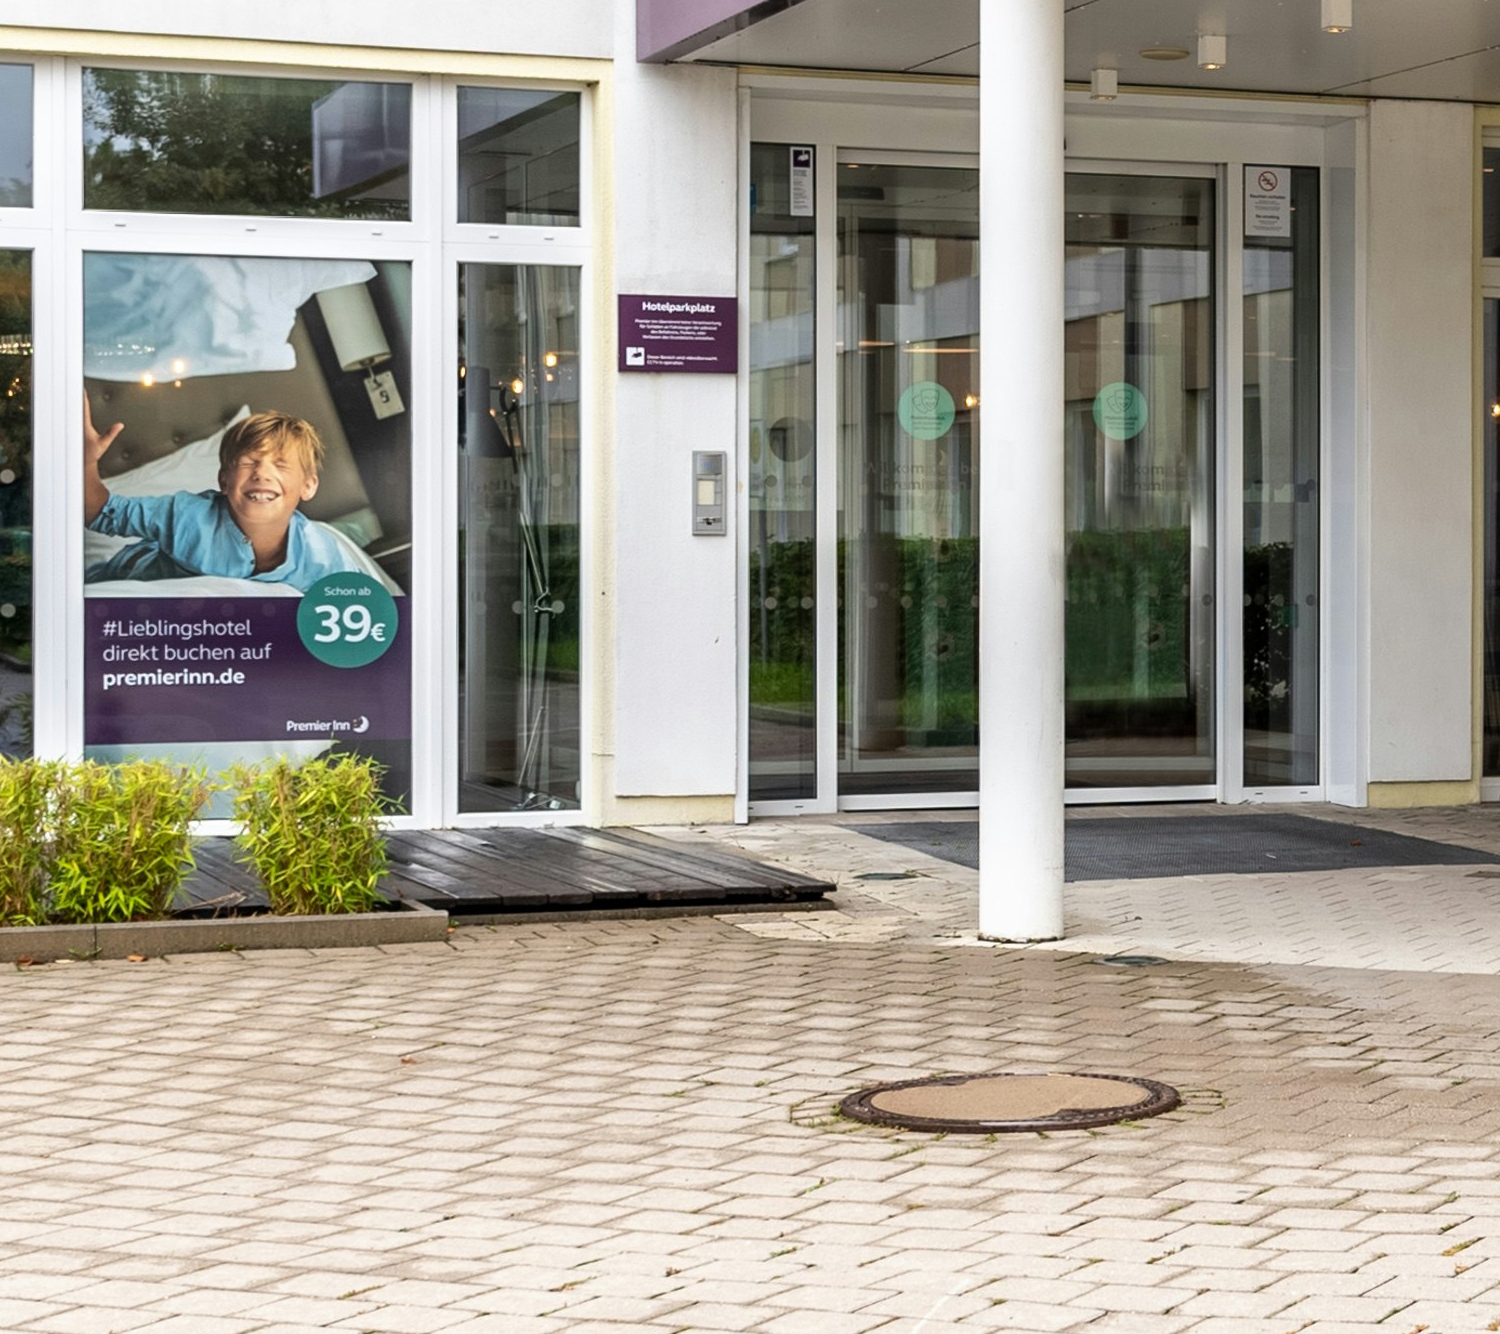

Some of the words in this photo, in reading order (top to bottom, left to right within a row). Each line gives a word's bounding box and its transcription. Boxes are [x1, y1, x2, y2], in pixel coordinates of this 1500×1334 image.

[642, 301, 716, 314] Hotelparkplatz
[324, 586, 356, 597] Schon
[358, 586, 372, 597] ab
[102, 619, 252, 640] #Lieblingshotel
[314, 604, 386, 644] 39€
[103, 645, 159, 662] direkt
[164, 644, 236, 661] buchen
[240, 643, 272, 660] auf
[103, 668, 246, 690] premierinn.de
[286, 719, 332, 732] Premier
[332, 720, 350, 731] Inn
